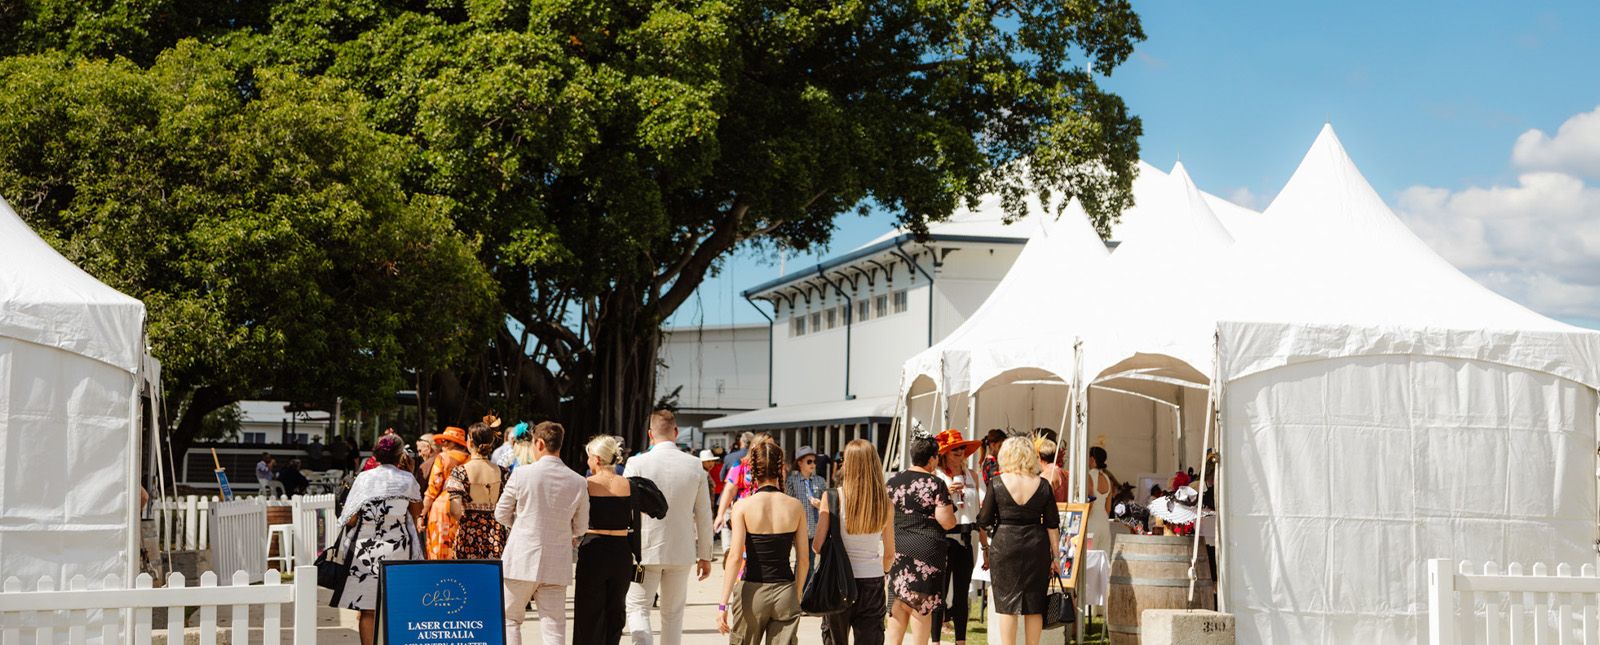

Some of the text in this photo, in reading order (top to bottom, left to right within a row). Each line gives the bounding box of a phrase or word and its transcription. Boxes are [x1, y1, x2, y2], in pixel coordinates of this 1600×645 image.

[408, 620, 484, 631] LASER CLINICS
[417, 630, 475, 640] AUSTRALIA
